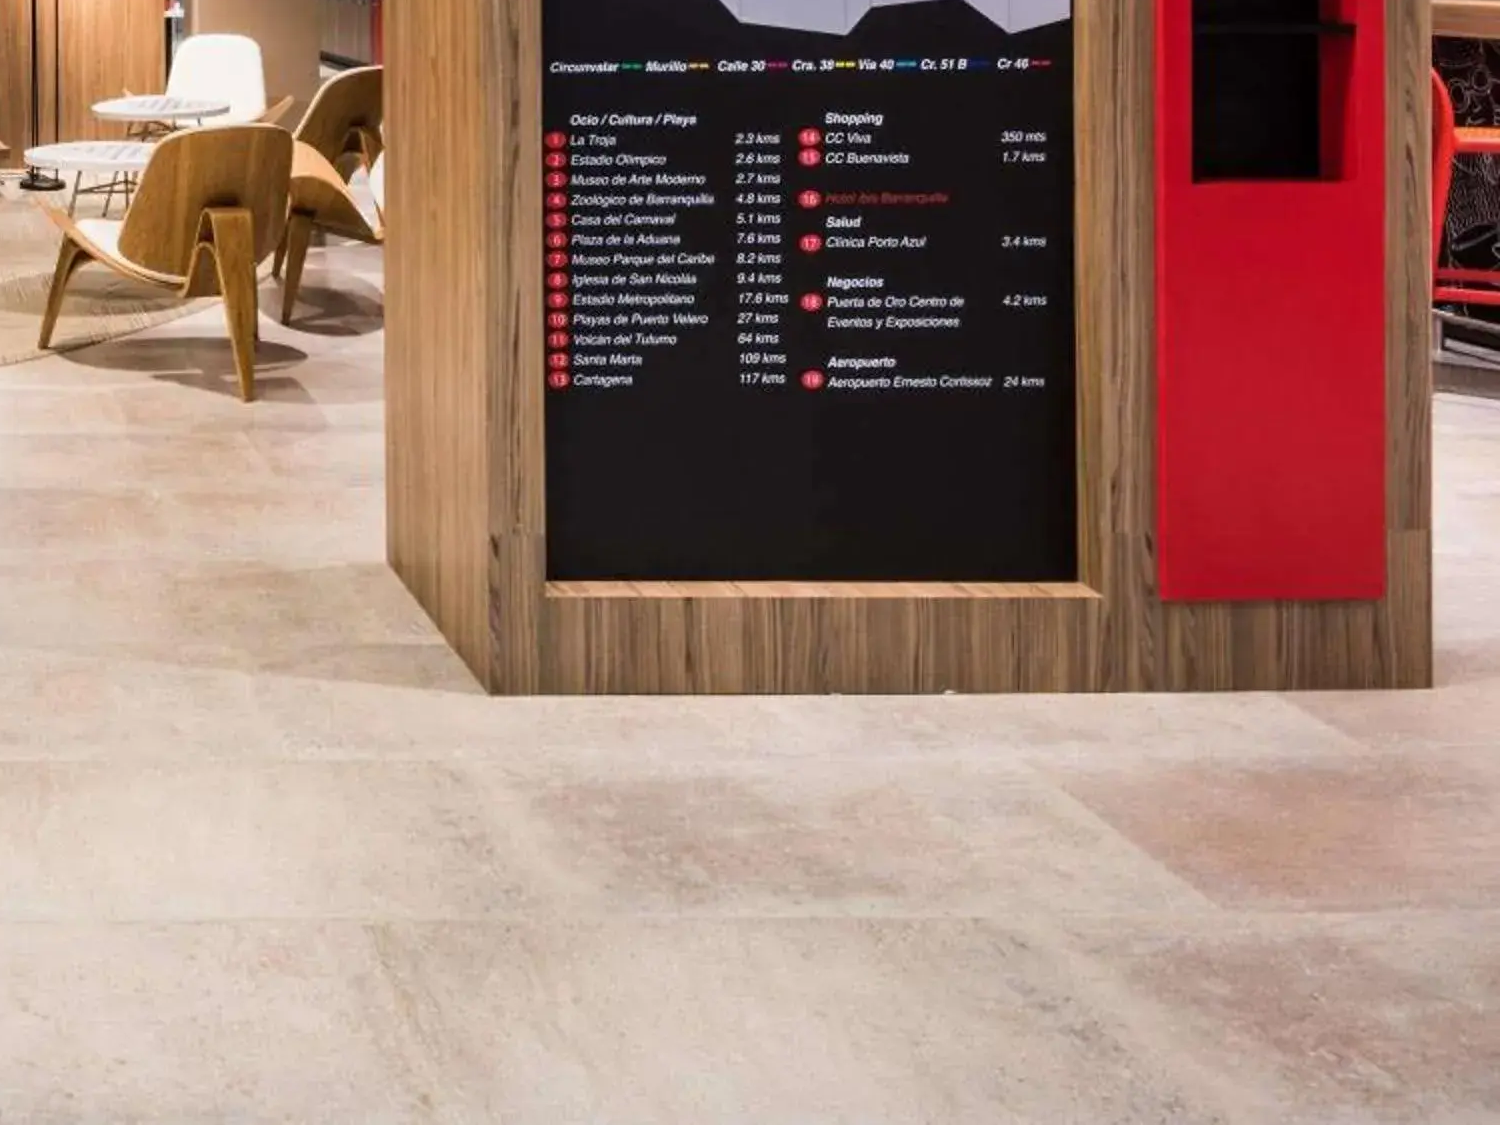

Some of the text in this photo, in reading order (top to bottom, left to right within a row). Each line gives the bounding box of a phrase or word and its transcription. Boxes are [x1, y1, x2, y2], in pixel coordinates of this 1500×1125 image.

[550, 62, 619, 73] Circunvalar
[718, 60, 766, 72] Calle 30
[940, 59, 955, 69] 51
[958, 59, 967, 69] B
[997, 58, 1012, 69] Cr
[570, 113, 697, 127] Ocio / Cultura / Playa
[825, 112, 884, 126] Shopping
[570, 135, 584, 145] La
[589, 135, 616, 147] Troja
[735, 133, 754, 144] 2.3
[756, 134, 780, 144] kms
[825, 132, 844, 143] CC
[847, 133, 871, 143] Viva
[1001, 131, 1023, 142] 350
[571, 155, 613, 165] Estadio
[736, 153, 754, 164] 2.6
[756, 154, 780, 164] kms
[825, 152, 844, 163] CC
[846, 153, 909, 163] Buenavista
[1022, 153, 1045, 161] kms
[571, 175, 609, 185] Museo
[612, 174, 626, 185] de
[628, 174, 652, 185] Arte
[656, 174, 706, 185] Moderno
[736, 173, 755, 184] 2.7
[756, 174, 780, 184] kms
[628, 195, 644, 205] de
[646, 193, 714, 206] Barranquilla
[757, 194, 780, 203] kms
[572, 214, 601, 225] Casa
[604, 214, 622, 225] del
[624, 213, 676, 225] Carnaval
[736, 213, 753, 224] 5.1
[757, 214, 781, 223] kms
[826, 216, 862, 228] Salud
[572, 234, 603, 245] Plaza
[606, 235, 621, 245] de
[624, 235, 634, 244] la
[636, 234, 680, 245] Aduana
[758, 234, 781, 243] kms
[868, 236, 898, 247] Porto
[900, 236, 926, 247] Azul
[1002, 237, 1020, 247] 3.4
[1023, 237, 1046, 247] kms
[572, 254, 610, 265] Museo
[613, 254, 654, 267] Parque
[657, 254, 675, 264] del
[677, 253, 715, 264] Caribe
[736, 253, 756, 264] 8.2
[758, 253, 781, 263] kms
[572, 275, 609, 287] Iglesia
[612, 275, 626, 285] de
[629, 273, 653, 285] San
[758, 273, 782, 283] kms
[827, 277, 884, 290] Negocios
[573, 294, 615, 305] Estadio
[617, 293, 695, 307] Metropolitano
[765, 293, 788, 303] kms
[827, 296, 864, 307] Puerta
[867, 297, 882, 307] de
[885, 296, 906, 307] Oro
[908, 296, 946, 307] Centro
[949, 297, 964, 306] de
[1003, 295, 1021, 305] 4.2
[1024, 297, 1047, 305] kms
[573, 314, 611, 327] Playas
[613, 314, 628, 325] de
[631, 313, 669, 325] Puerto
[673, 313, 708, 324] Velero
[737, 313, 753, 324] 27
[755, 313, 778, 323] kms
[828, 316, 960, 329] Eventos y Exposiciones
[614, 334, 632, 345] del
[738, 333, 752, 344] 64
[756, 333, 779, 343] kms
[574, 354, 607, 365] Santa
[610, 354, 642, 365] Marta
[762, 353, 786, 363] kms
[828, 357, 896, 370] Aeropuerto
[574, 374, 633, 387] Cartagena
[740, 373, 760, 383] 117
[762, 373, 785, 383] kms
[828, 377, 891, 389] Aeropuerto
[893, 376, 937, 387] Ernesto
[1004, 376, 1019, 387] 24
[1021, 377, 1044, 386] kms
